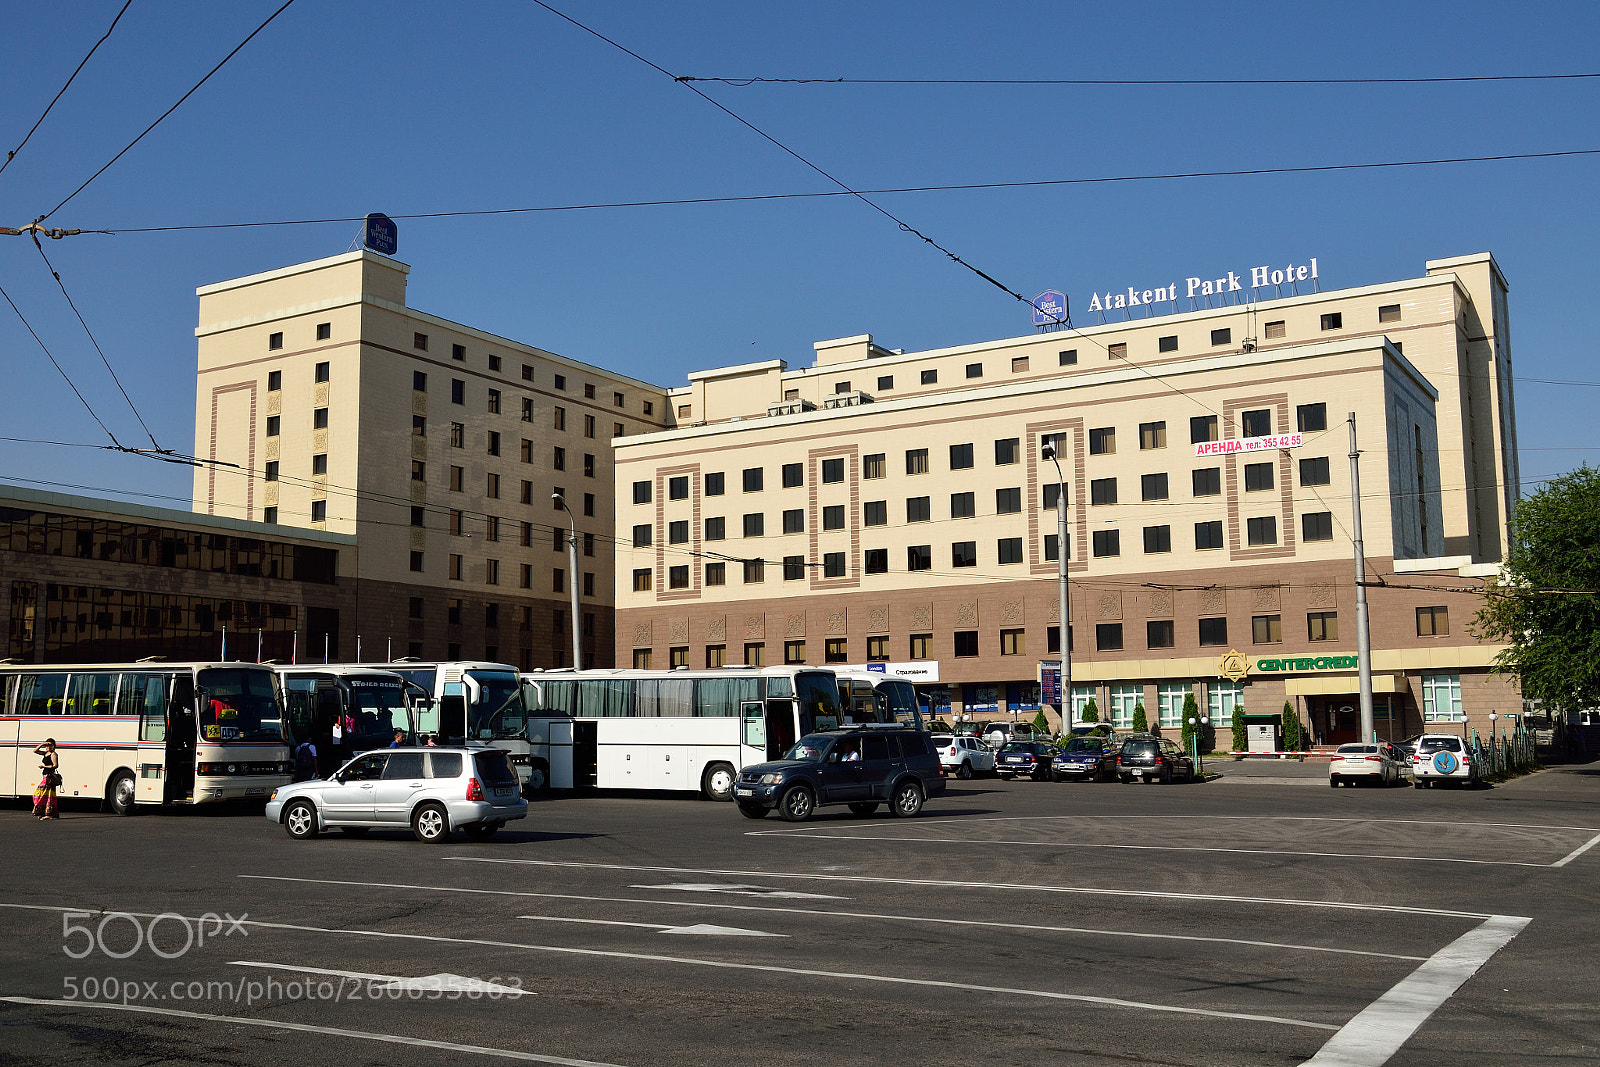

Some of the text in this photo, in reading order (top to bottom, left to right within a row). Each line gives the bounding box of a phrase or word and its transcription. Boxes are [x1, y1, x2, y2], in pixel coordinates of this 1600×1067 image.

[1088, 258, 1319, 312] Atakent Park Hotel
[1041, 300, 1056, 310] Best
[1197, 435, 1301, 455] АРЕНДА тел: 355 42 55
[1257, 655, 1359, 671] CENTERCREDI
